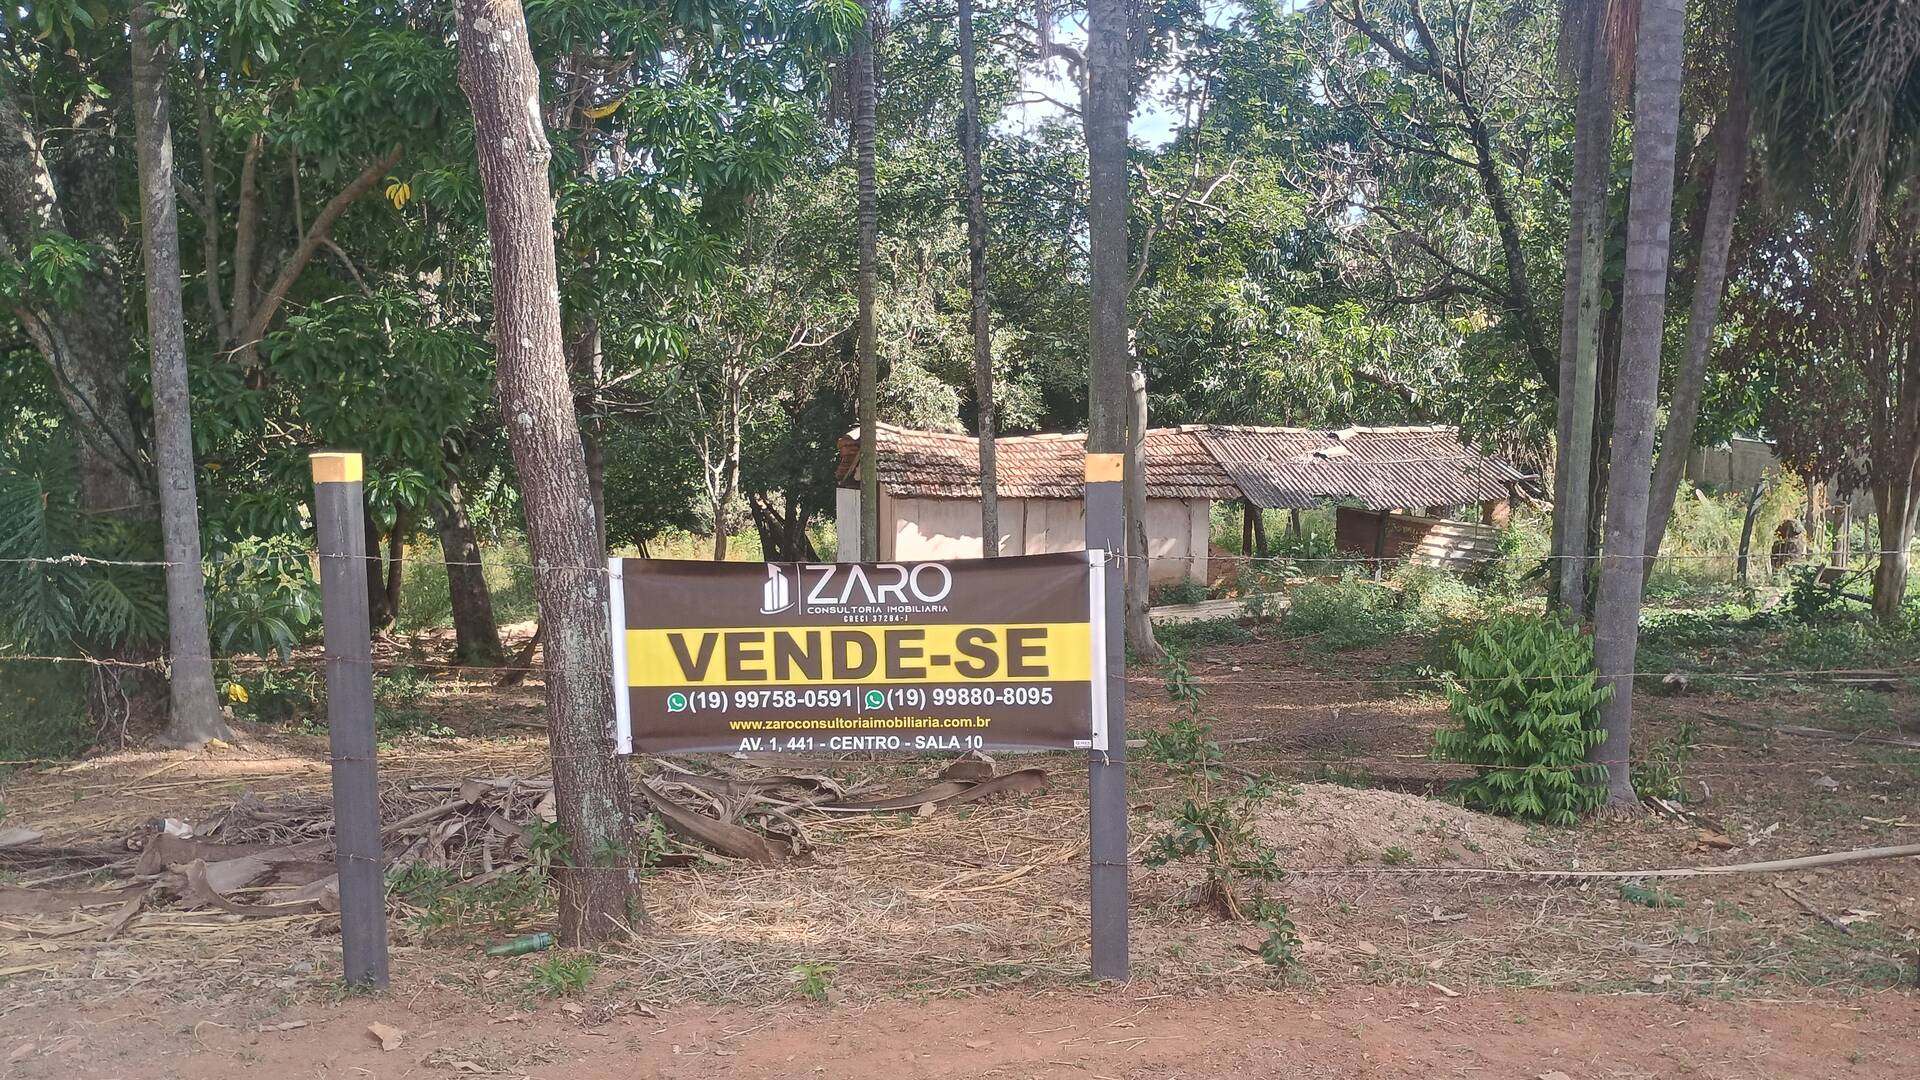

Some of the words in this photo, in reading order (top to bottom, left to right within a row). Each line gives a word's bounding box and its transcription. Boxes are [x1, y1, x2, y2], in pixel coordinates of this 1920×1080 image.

[806, 562, 953, 604] ZARO
[807, 606, 882, 614] CONSULTORIA
[887, 605, 948, 613] IMOBILIARIA
[843, 615, 868, 623] CRECI
[667, 627, 1049, 683] VENDE-SE
[689, 691, 728, 713] (19)
[735, 690, 851, 709] 99758-0591
[887, 688, 926, 710] (19)
[933, 687, 1053, 706] 99880-8095
[729, 716, 991, 730] www.zaroconsultoriaimobiliaria.com.br
[739, 737, 764, 751] AV.
[769, 737, 782, 752] 1,
[787, 737, 813, 751] 441
[830, 736, 900, 750] CENTRO
[916, 736, 960, 749] SALA
[965, 735, 983, 749] 10
